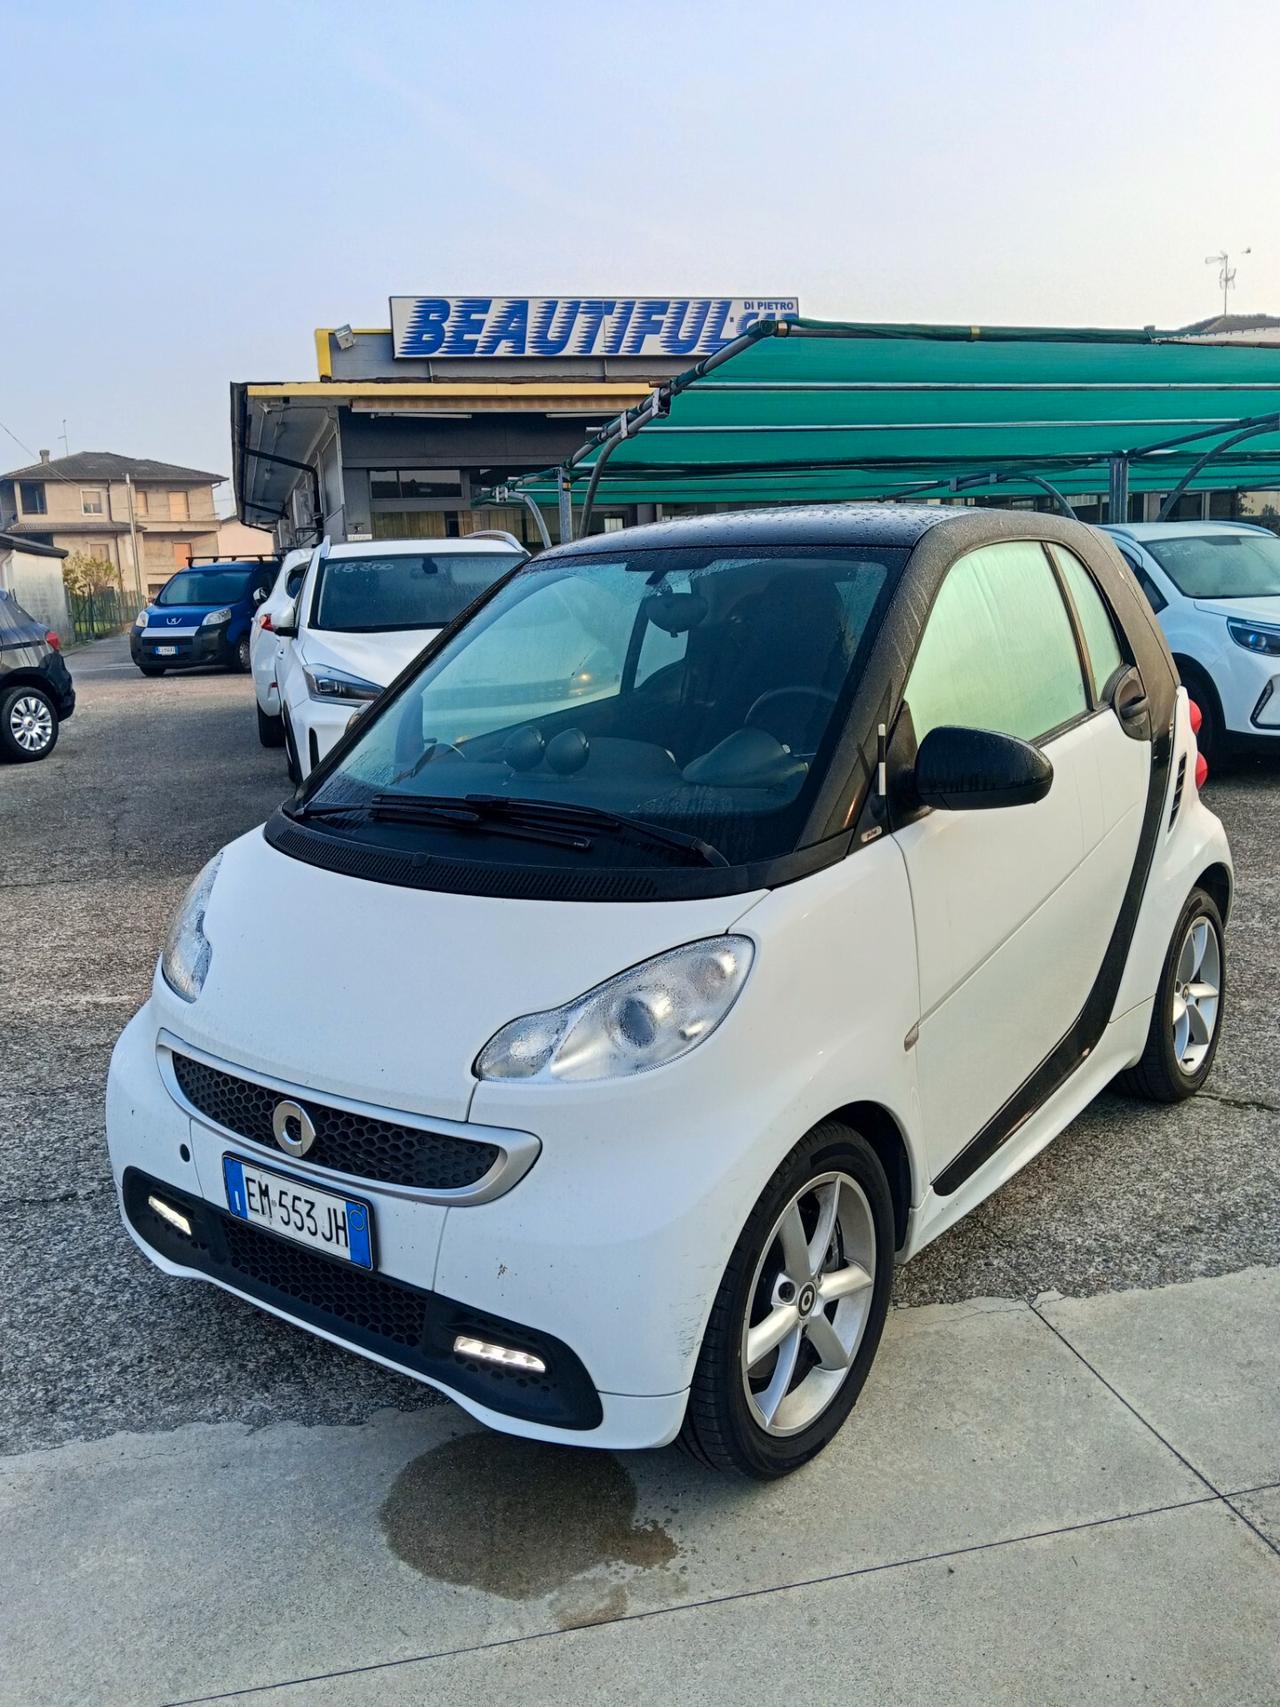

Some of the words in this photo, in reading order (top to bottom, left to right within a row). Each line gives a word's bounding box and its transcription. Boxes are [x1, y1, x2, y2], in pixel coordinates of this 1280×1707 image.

[744, 301, 754, 310] DI
[757, 301, 794, 310] PIETRO
[399, 299, 732, 355] BEAUTIFUL
